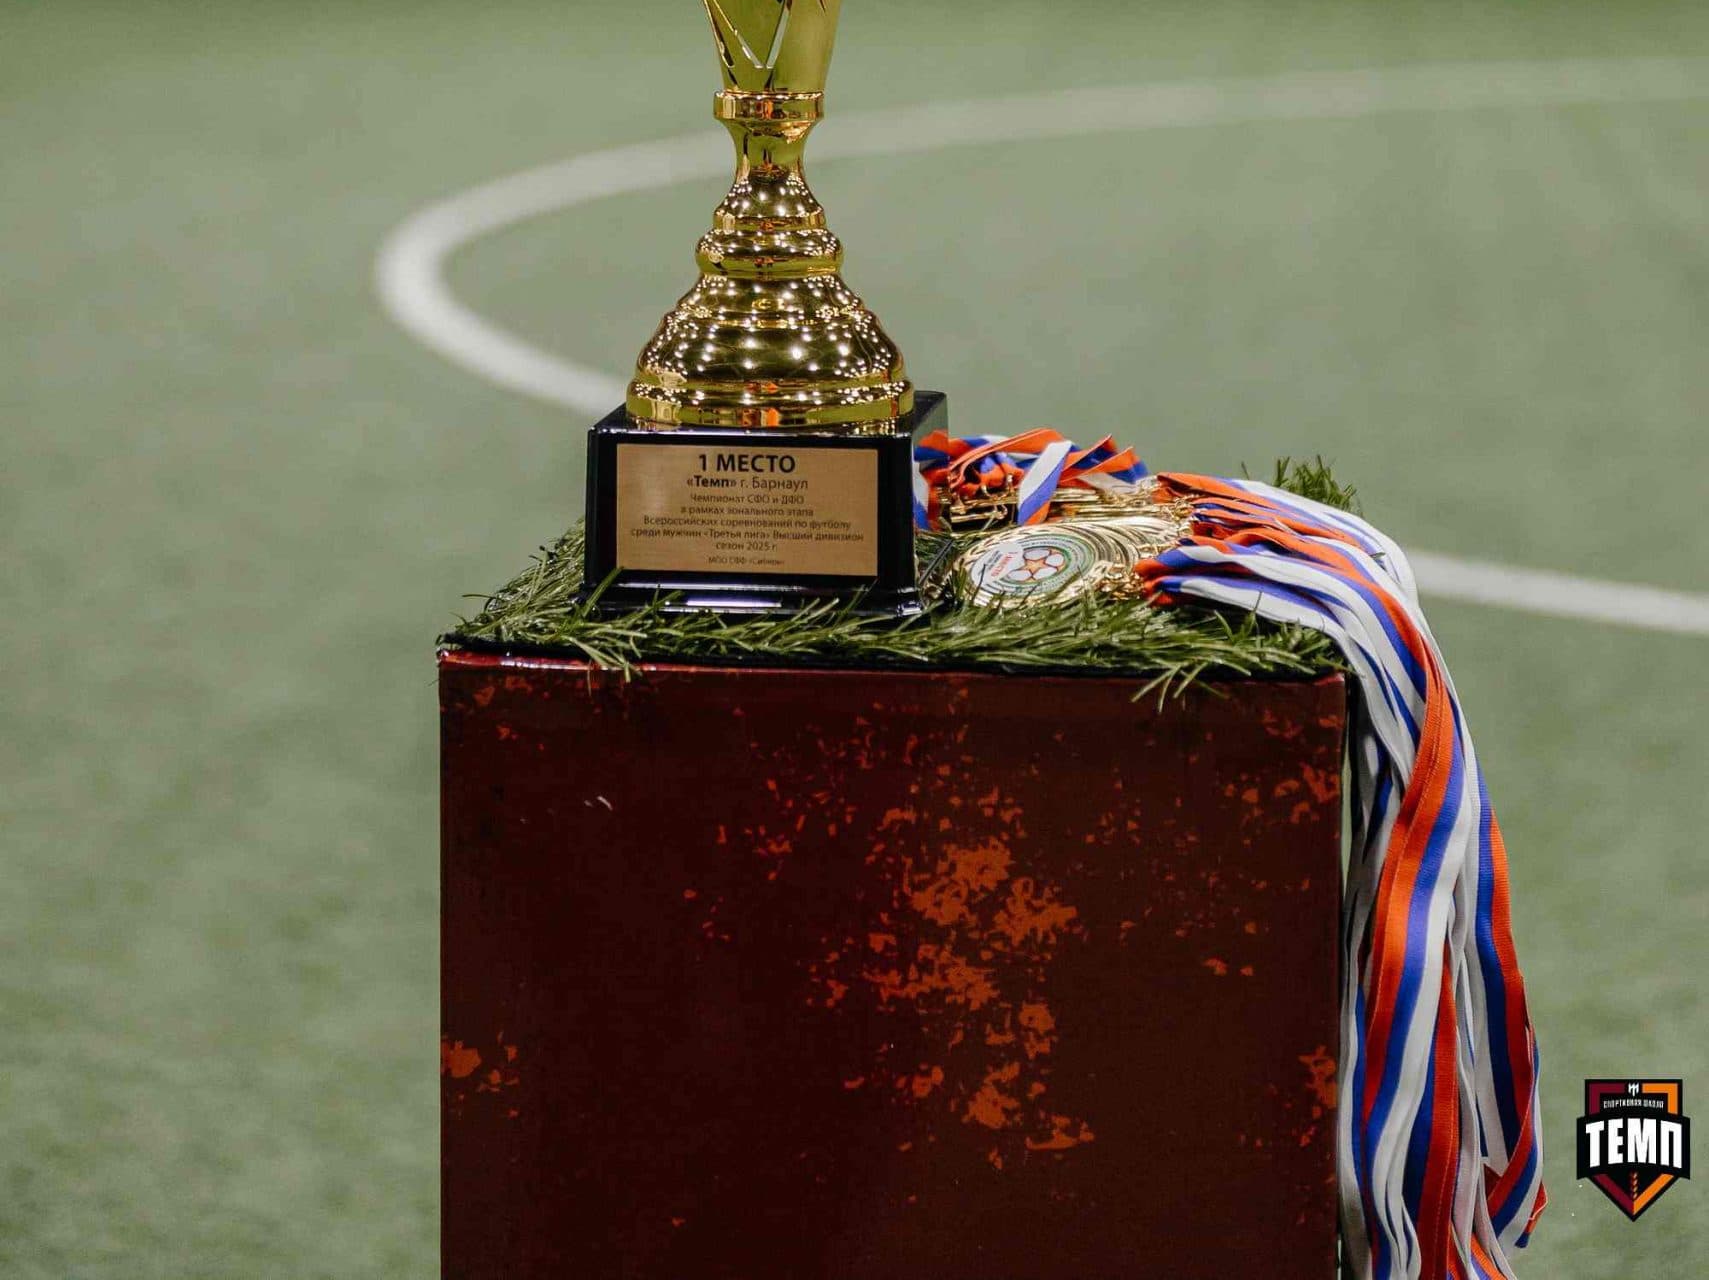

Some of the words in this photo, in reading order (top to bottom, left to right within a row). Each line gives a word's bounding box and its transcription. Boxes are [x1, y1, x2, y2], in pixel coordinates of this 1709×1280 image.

[699, 454, 707, 472] 1
[716, 454, 796, 473] МЕСТО
[687, 475, 736, 487] «Темп»
[740, 480, 748, 488] г.
[752, 476, 808, 492] Барнаул
[691, 494, 744, 503] Чемпионат
[747, 494, 769, 504] СФО
[772, 496, 778, 504] и
[781, 495, 804, 505] ДФО
[689, 507, 724, 515] рамках
[727, 507, 784, 516] зонального
[788, 508, 814, 516] этапа
[644, 515, 717, 526] Всероссийских
[720, 518, 793, 528] соревнований
[809, 520, 851, 530] футболу
[631, 529, 660, 538] среди
[663, 529, 701, 538] мужчин
[815, 533, 864, 541] дивизион
[716, 542, 744, 550] сезон
[747, 542, 770, 551] 2025
